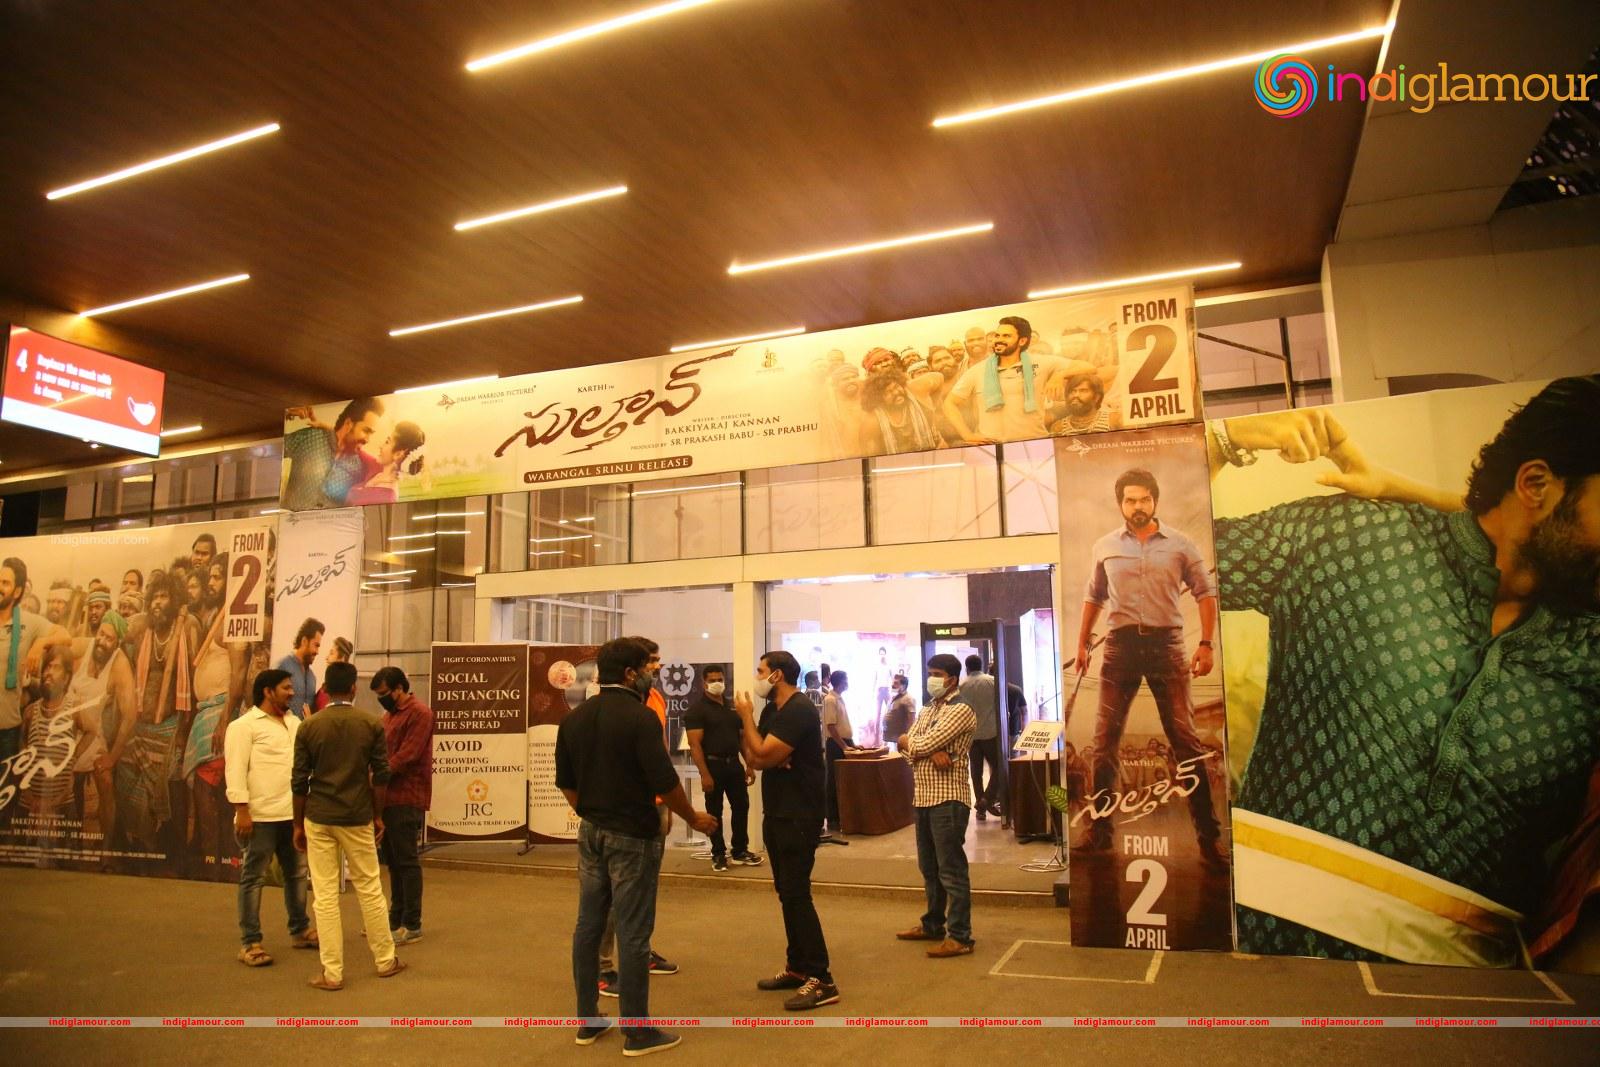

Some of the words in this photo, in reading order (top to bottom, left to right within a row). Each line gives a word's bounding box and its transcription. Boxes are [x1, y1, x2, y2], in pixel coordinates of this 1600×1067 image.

[1122, 298, 1178, 325] FROM
[16, 348, 28, 373] 4
[1126, 324, 1179, 394] 2
[456, 395, 476, 403] DREAM
[477, 391, 504, 400] WARRIOR
[577, 384, 607, 393] KARTHI
[1129, 392, 1185, 419] APRIL
[665, 421, 728, 436] BAKKIYARAJ
[732, 415, 781, 428] KANNAN
[671, 438, 682, 447] SR
[684, 433, 726, 446] PRAKASH
[729, 430, 754, 441] BABU
[762, 428, 775, 437] SR
[777, 422, 819, 436] PRABHU
[1092, 442, 1119, 450] DREAM
[1120, 439, 1156, 448] WARRIOR
[527, 467, 592, 483] WARANGAL
[595, 463, 634, 475] SRINU
[637, 457, 690, 473] RELEASE
[233, 532, 265, 553] FROM
[229, 555, 262, 615] 2
[227, 618, 259, 637] APRIL
[466, 655, 516, 663] CORONAVIRUS
[437, 672, 488, 684] SOCIAL
[437, 689, 520, 701] DISTANCING
[436, 710, 470, 719] HELPS
[472, 709, 520, 719] PREVENT
[437, 721, 457, 730] THE
[459, 721, 500, 730] SPREAD
[436, 740, 482, 752] AVOID
[439, 757, 489, 765] CROWDING
[439, 766, 470, 774] GROUP
[471, 765, 524, 773] GATHERING
[463, 802, 493, 820] JRC
[1124, 835, 1169, 856] FROM
[1125, 859, 1168, 926] 2
[1125, 928, 1170, 950] APRIL
